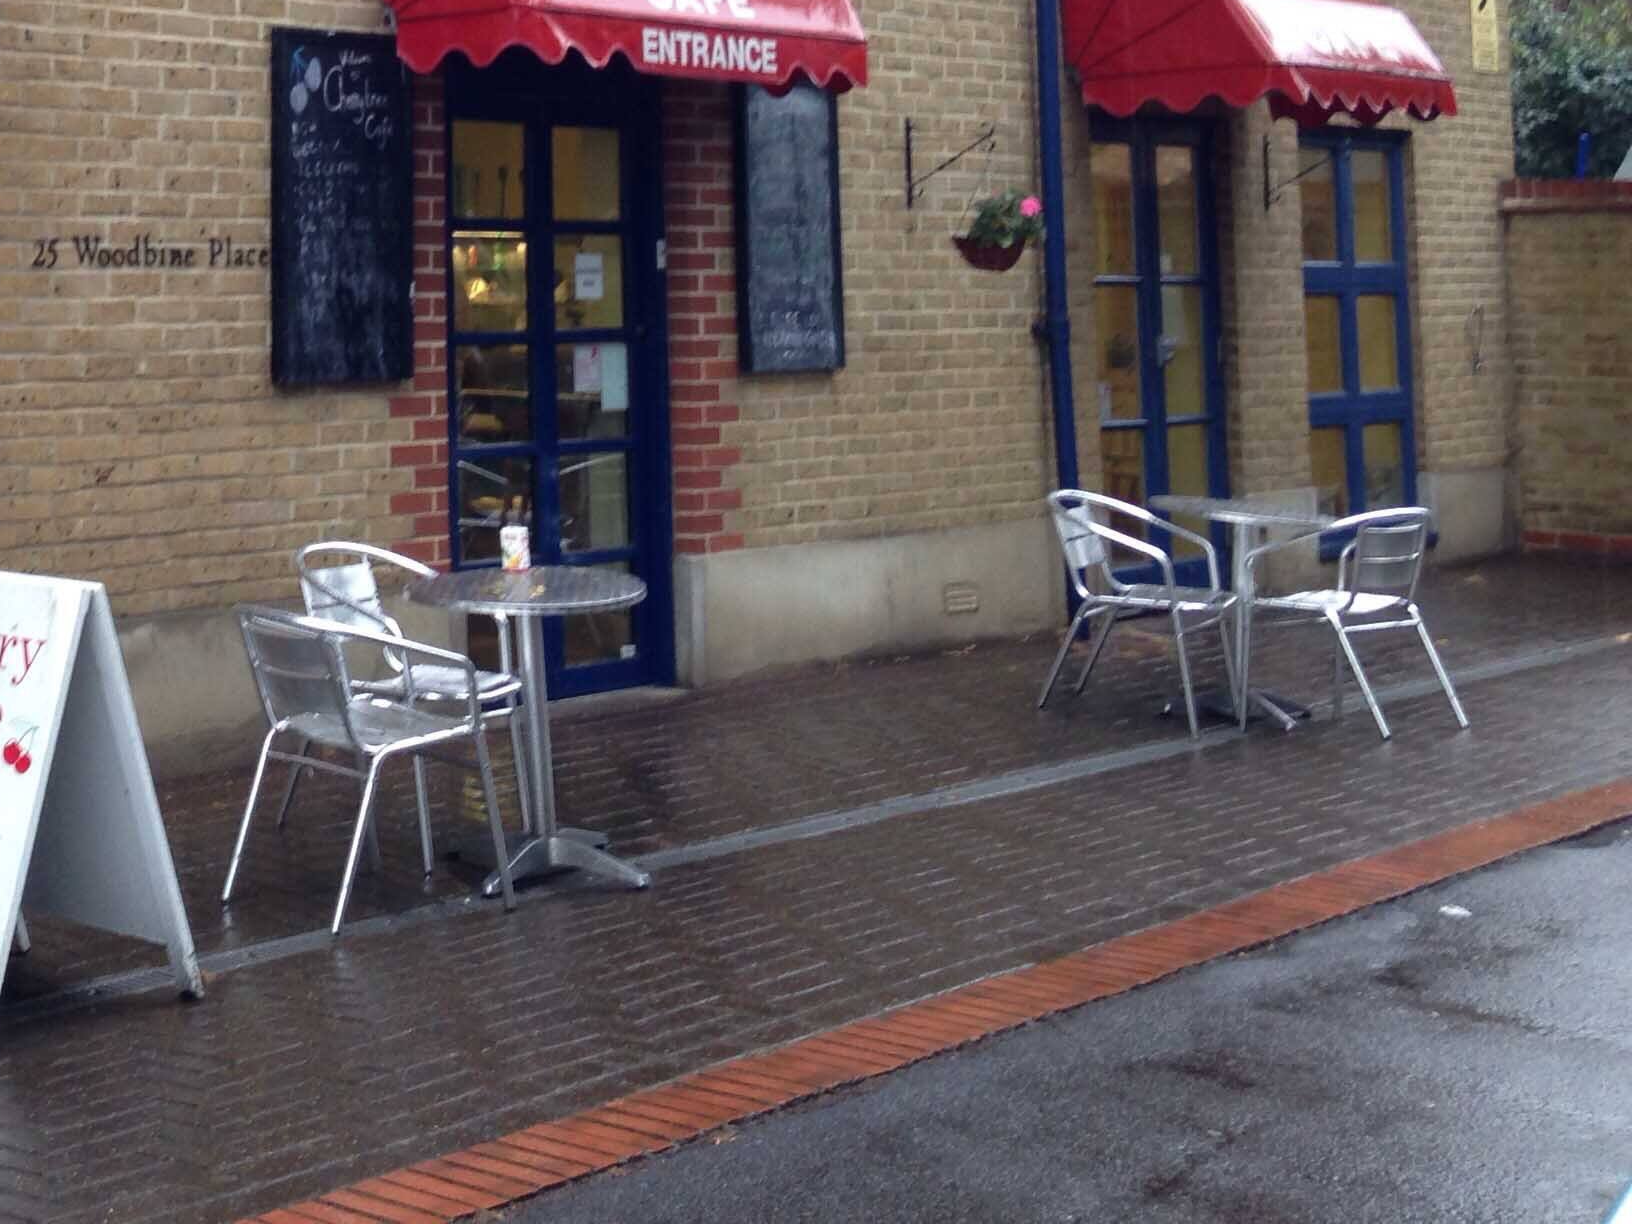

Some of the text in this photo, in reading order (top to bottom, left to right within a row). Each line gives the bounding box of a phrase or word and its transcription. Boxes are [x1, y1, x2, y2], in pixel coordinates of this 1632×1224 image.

[642, 27, 778, 74] ENTRANCE
[32, 233, 269, 269] 25 Woodbine Place
